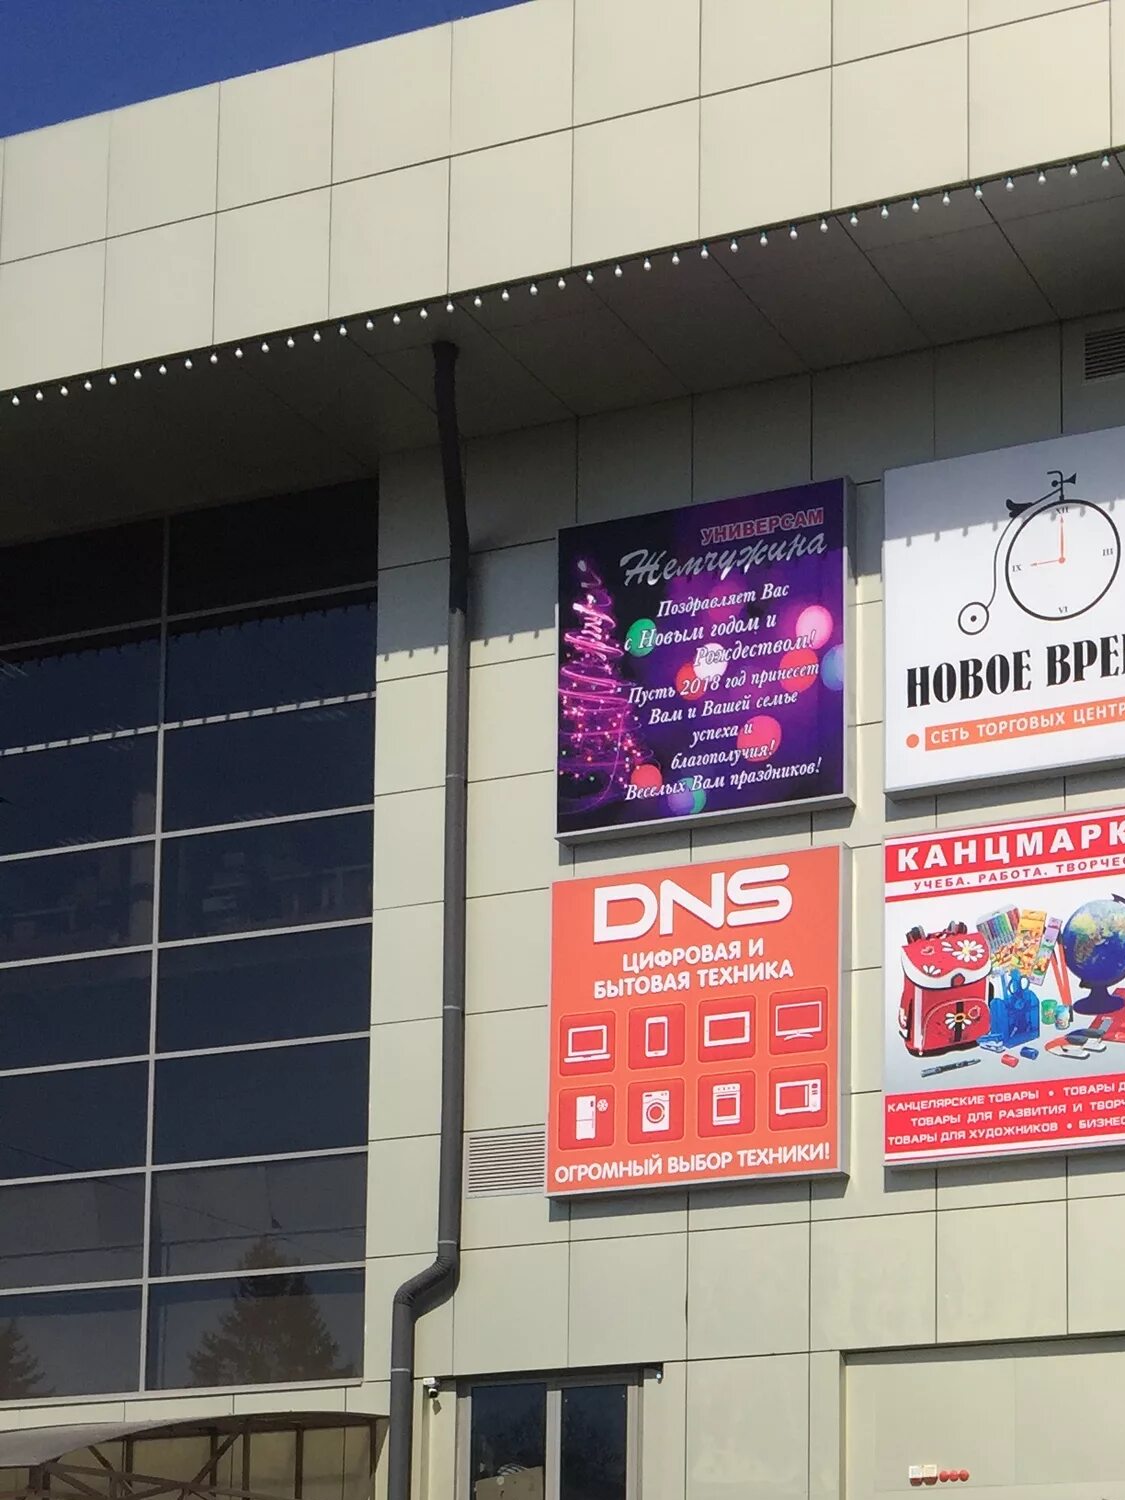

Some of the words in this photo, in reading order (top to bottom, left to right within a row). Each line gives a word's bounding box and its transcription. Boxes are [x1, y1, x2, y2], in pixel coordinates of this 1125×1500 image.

[701, 507, 824, 546] УНИВЕРСАМ
[620, 533, 827, 586] Жемчужина
[657, 591, 756, 618] Поздравляет
[760, 584, 789, 598] Вас
[639, 626, 704, 649] Новым
[710, 617, 760, 641] годом
[766, 615, 777, 628] и
[694, 630, 817, 666] Рождеством!
[628, 686, 676, 707] Пусть
[680, 676, 721, 696] 2018
[725, 673, 747, 690] год
[751, 663, 820, 687] принесет
[906, 650, 1032, 708] НОВОЕ
[649, 707, 684, 725] Вам
[687, 707, 696, 719] и
[701, 695, 751, 718] Вашей
[756, 692, 798, 708] семье
[690, 726, 739, 748] успеха
[741, 723, 753, 736] и
[930, 728, 969, 744] СЕТЬ
[977, 712, 1065, 738] ТОРГОВЫХ
[671, 740, 776, 770] благополучия!
[625, 780, 687, 801] Веселых
[691, 774, 726, 791] Вам
[730, 758, 822, 787] праздников!
[914, 876, 971, 891] УЧЕБА.
[978, 867, 1048, 884] РАБОТА.
[593, 864, 793, 943] DNS
[622, 940, 741, 974] ЦИФРОВАЯ
[749, 938, 764, 957] И
[594, 970, 690, 999] БЫТОВАЯ
[697, 959, 794, 988] ТЕХНИКА
[888, 1095, 984, 1112] КАНЦЕЛЯРСКИЕ
[988, 1090, 1040, 1104] ТОВАРЫ
[1063, 1083, 1115, 1096] ТОВАРЫ
[911, 1114, 961, 1127] ТОВАРЫ
[966, 1110, 992, 1123] ДЛЯ
[998, 1104, 1067, 1120] РАЗВИТИЯ
[1072, 1102, 1083, 1112] И
[888, 1133, 937, 1145] ТОВАРЫ
[940, 1130, 967, 1143] ДЛЯ
[969, 1121, 1058, 1140] ХУДОЖНИКОВ
[555, 1154, 663, 1183] ОГРОМНЫЙ
[668, 1152, 732, 1172] ВЫБОР
[737, 1142, 830, 1166] ТЕХНИКИ!
